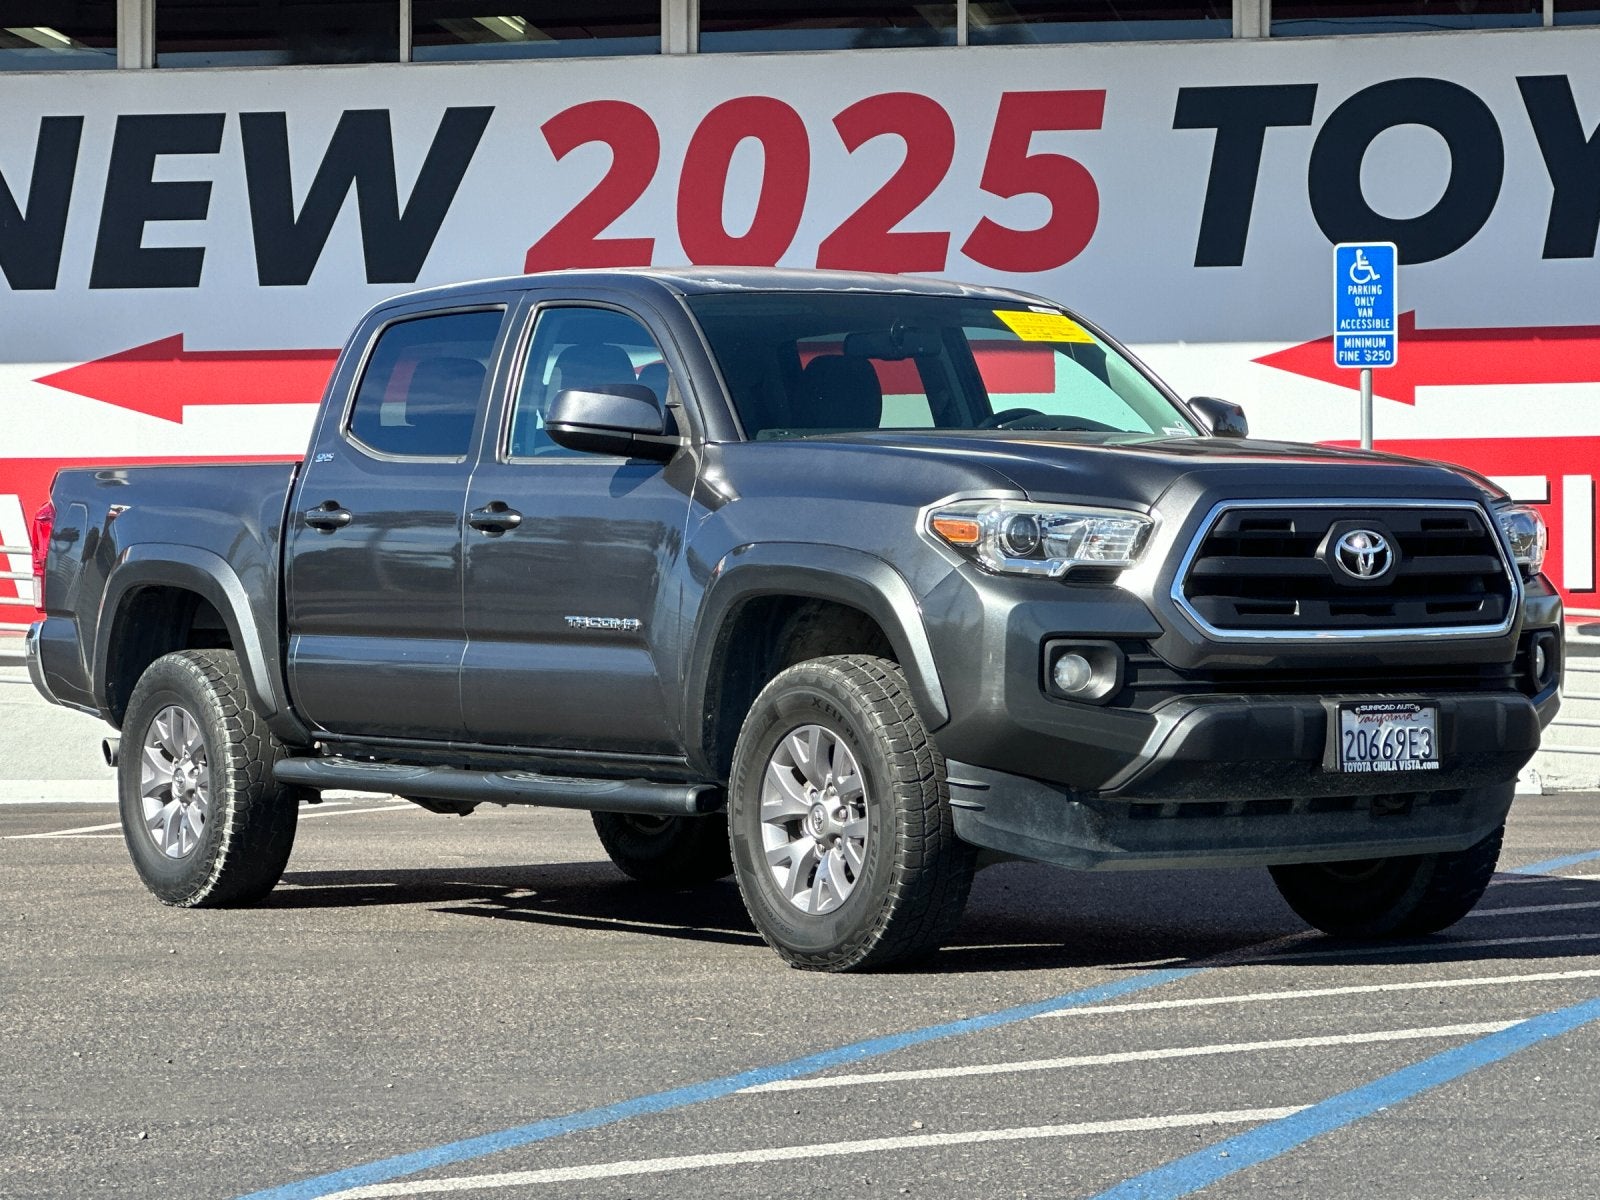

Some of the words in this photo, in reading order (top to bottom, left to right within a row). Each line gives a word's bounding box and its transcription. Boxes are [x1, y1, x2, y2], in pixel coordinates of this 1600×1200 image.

[0, 105, 495, 290] NEW
[524, 89, 1106, 273] 2025
[1347, 285, 1382, 295] PARKING
[1354, 297, 1375, 307] ONLY
[1357, 307, 1373, 318] VAN
[1340, 318, 1390, 329] ACCESSIBLE
[1344, 338, 1386, 348] MINIMUM
[1339, 351, 1360, 361] FINE
[1364, 350, 1391, 362] $250
[1344, 728, 1433, 761] 20669E3
[1343, 761, 1372, 772] TOYOTA
[1372, 760, 1398, 771] CHULA
[1398, 759, 1440, 771] VISTA.com
